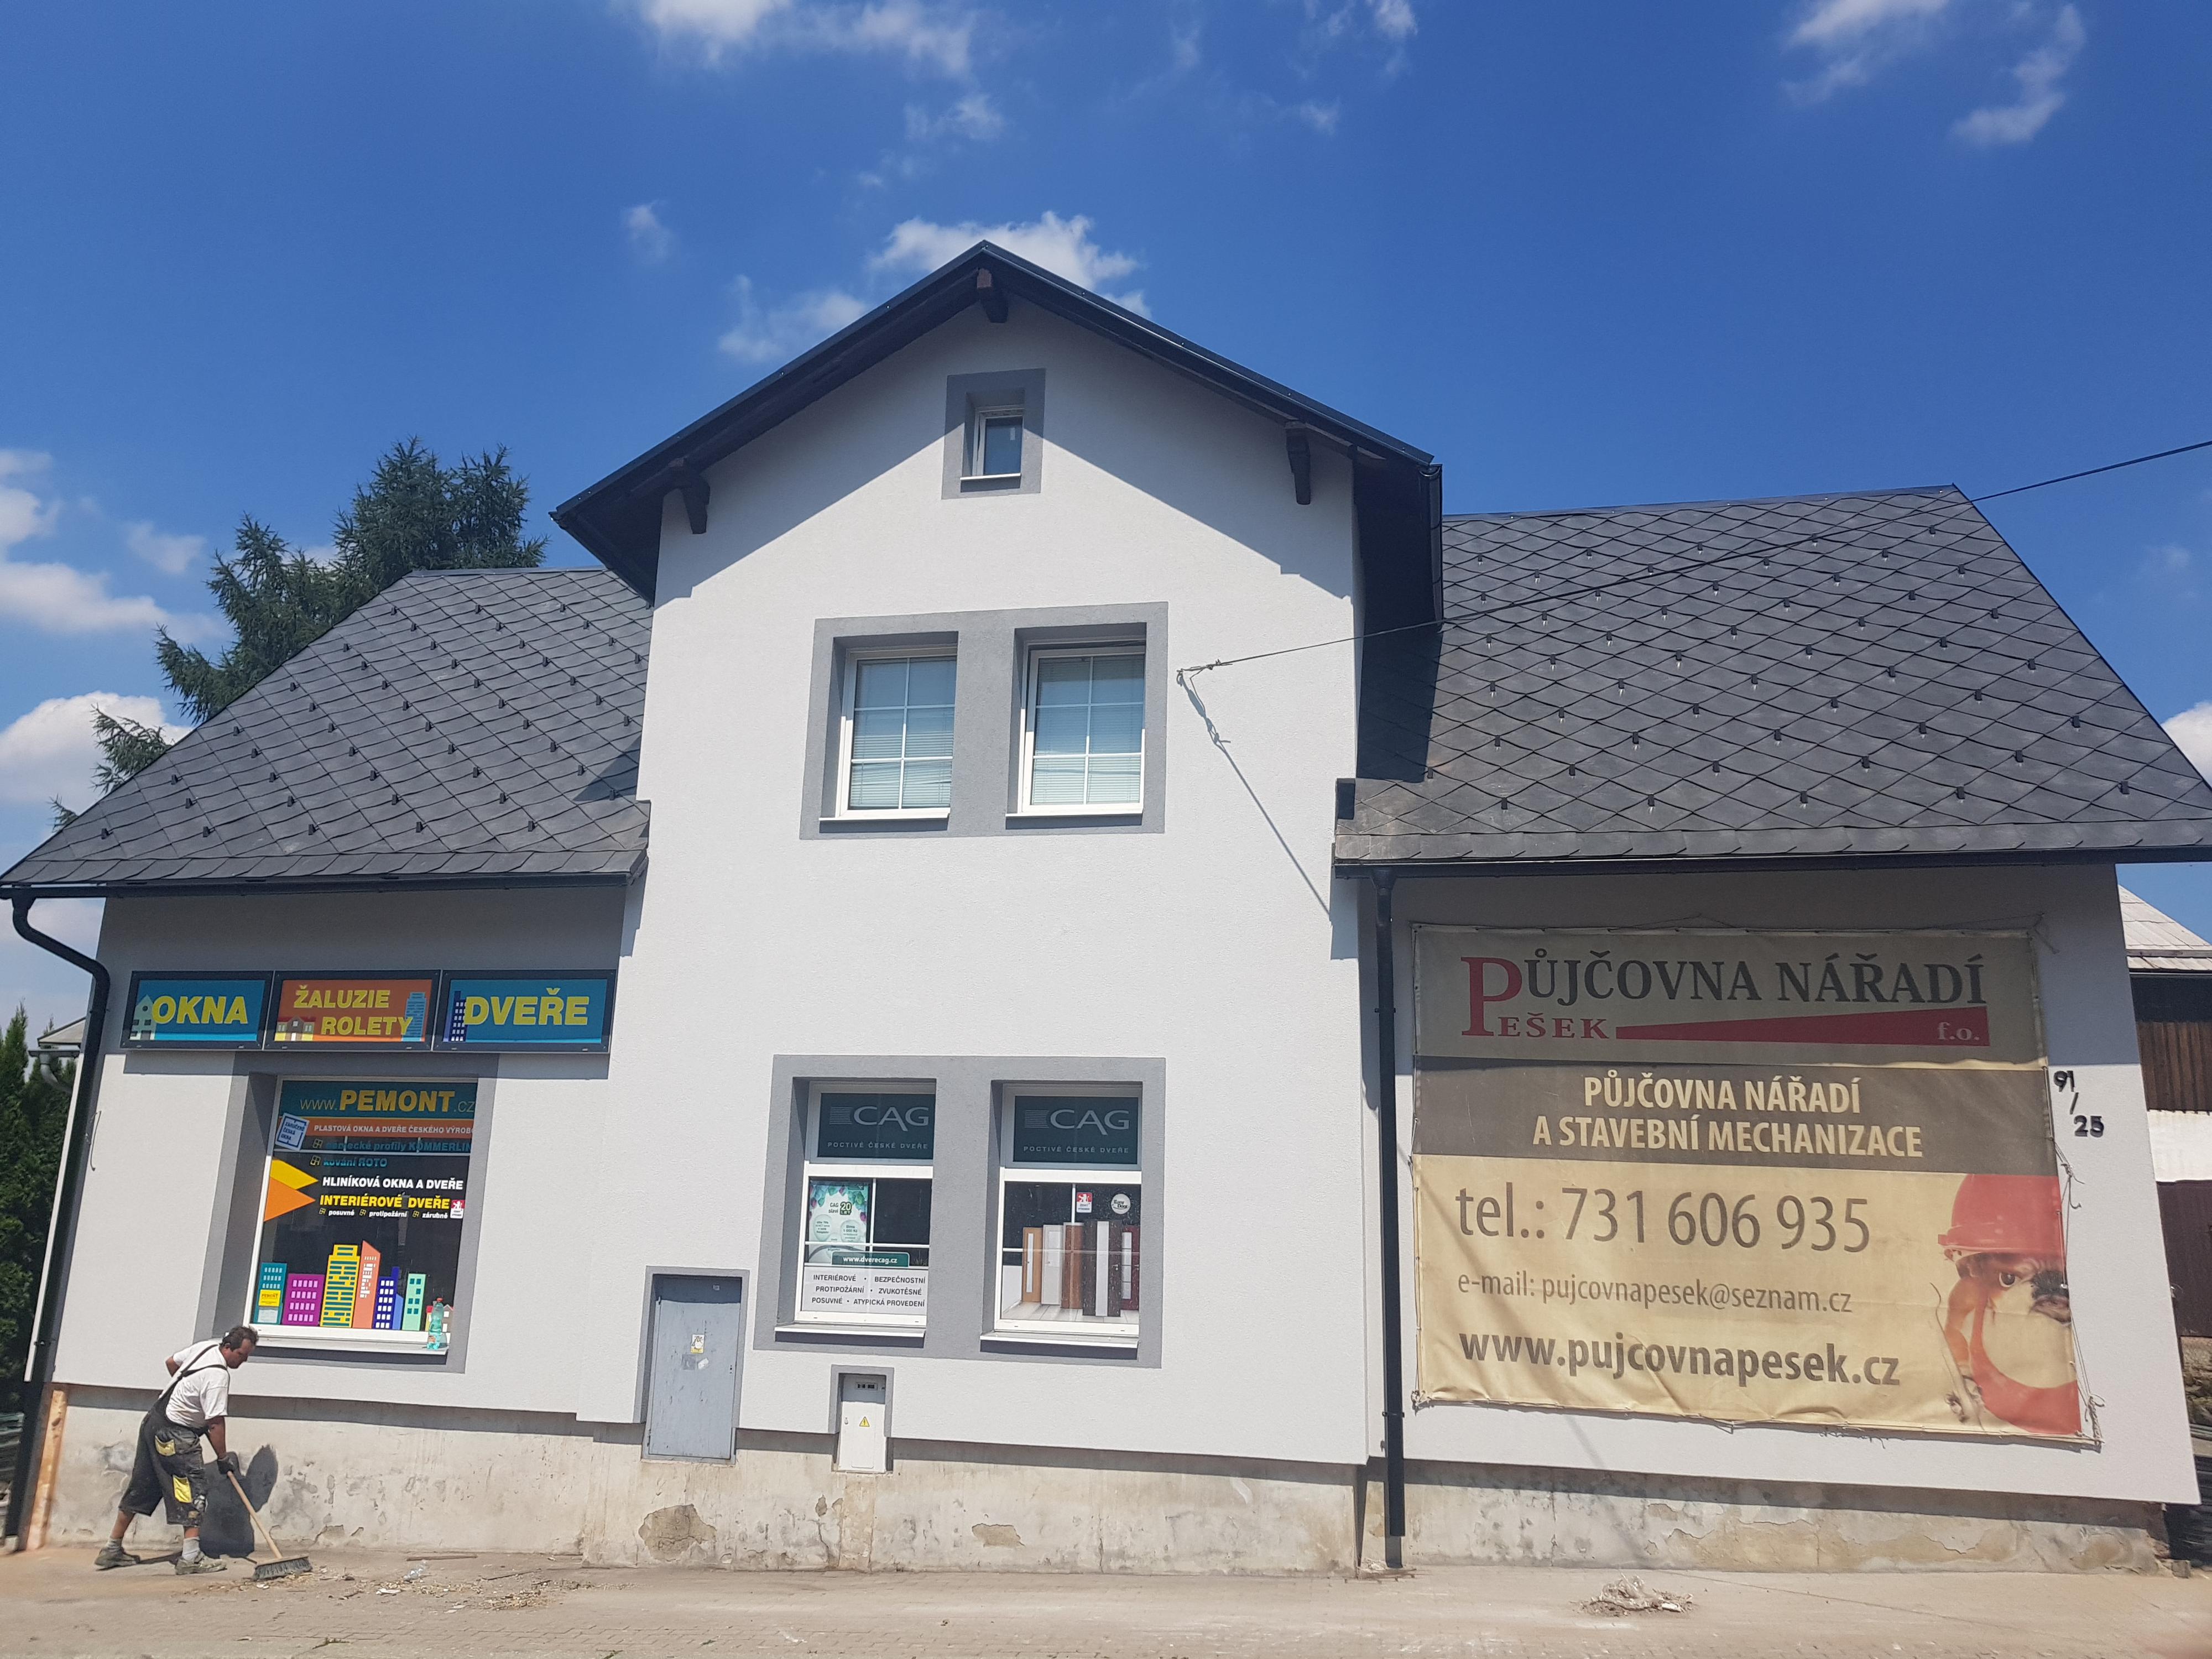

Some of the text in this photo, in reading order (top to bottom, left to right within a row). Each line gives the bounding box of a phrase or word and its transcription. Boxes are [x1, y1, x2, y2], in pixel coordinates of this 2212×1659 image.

[294, 985, 390, 1008] ŽALUZIE
[1461, 948, 1987, 1037] PŮJČOVNA NÁŘADÍ
[152, 995, 248, 1024] OKNA
[463, 987, 589, 1025] DVEŘE
[320, 1016, 413, 1035] ROLETY
[1937, 1021, 1980, 1041] f.o.
[1584, 1069, 1862, 1114] PŮJČOVNA NÁŘADÍ
[2053, 1071, 2075, 1092] 91
[446, 1125, 474, 1134] VÝROB
[854, 1106, 929, 1131] CAG
[1050, 1109, 1129, 1135] CAG
[2074, 1115, 2104, 1138] 25
[374, 1141, 406, 1151] profily
[1533, 1114, 1923, 1157] A STAVEBNÍ MECHANIZACE
[358, 1157, 388, 1167] ROTO
[322, 1175, 463, 1190] HLINÍKOVÁ OKNA A DVEŘE
[320, 1193, 450, 1209] INTERIÉROVÉ DVEŘE
[841, 1202, 852, 1211] 20
[1455, 1182, 1870, 1253] tel.: 731 606 935
[843, 1256, 898, 1265] www.dverecag.cz
[816, 1285, 922, 1295] PROTIPOŽÁRNÍ ZVUKOTĚSNÉ
[874, 1276, 926, 1284] BEZPEČNOSTNÍ
[1458, 1270, 1853, 1313] e-mail: pujcovnapesek@seznam.cz
[1459, 1332, 1901, 1387] www.pujcovnapesek.cz
